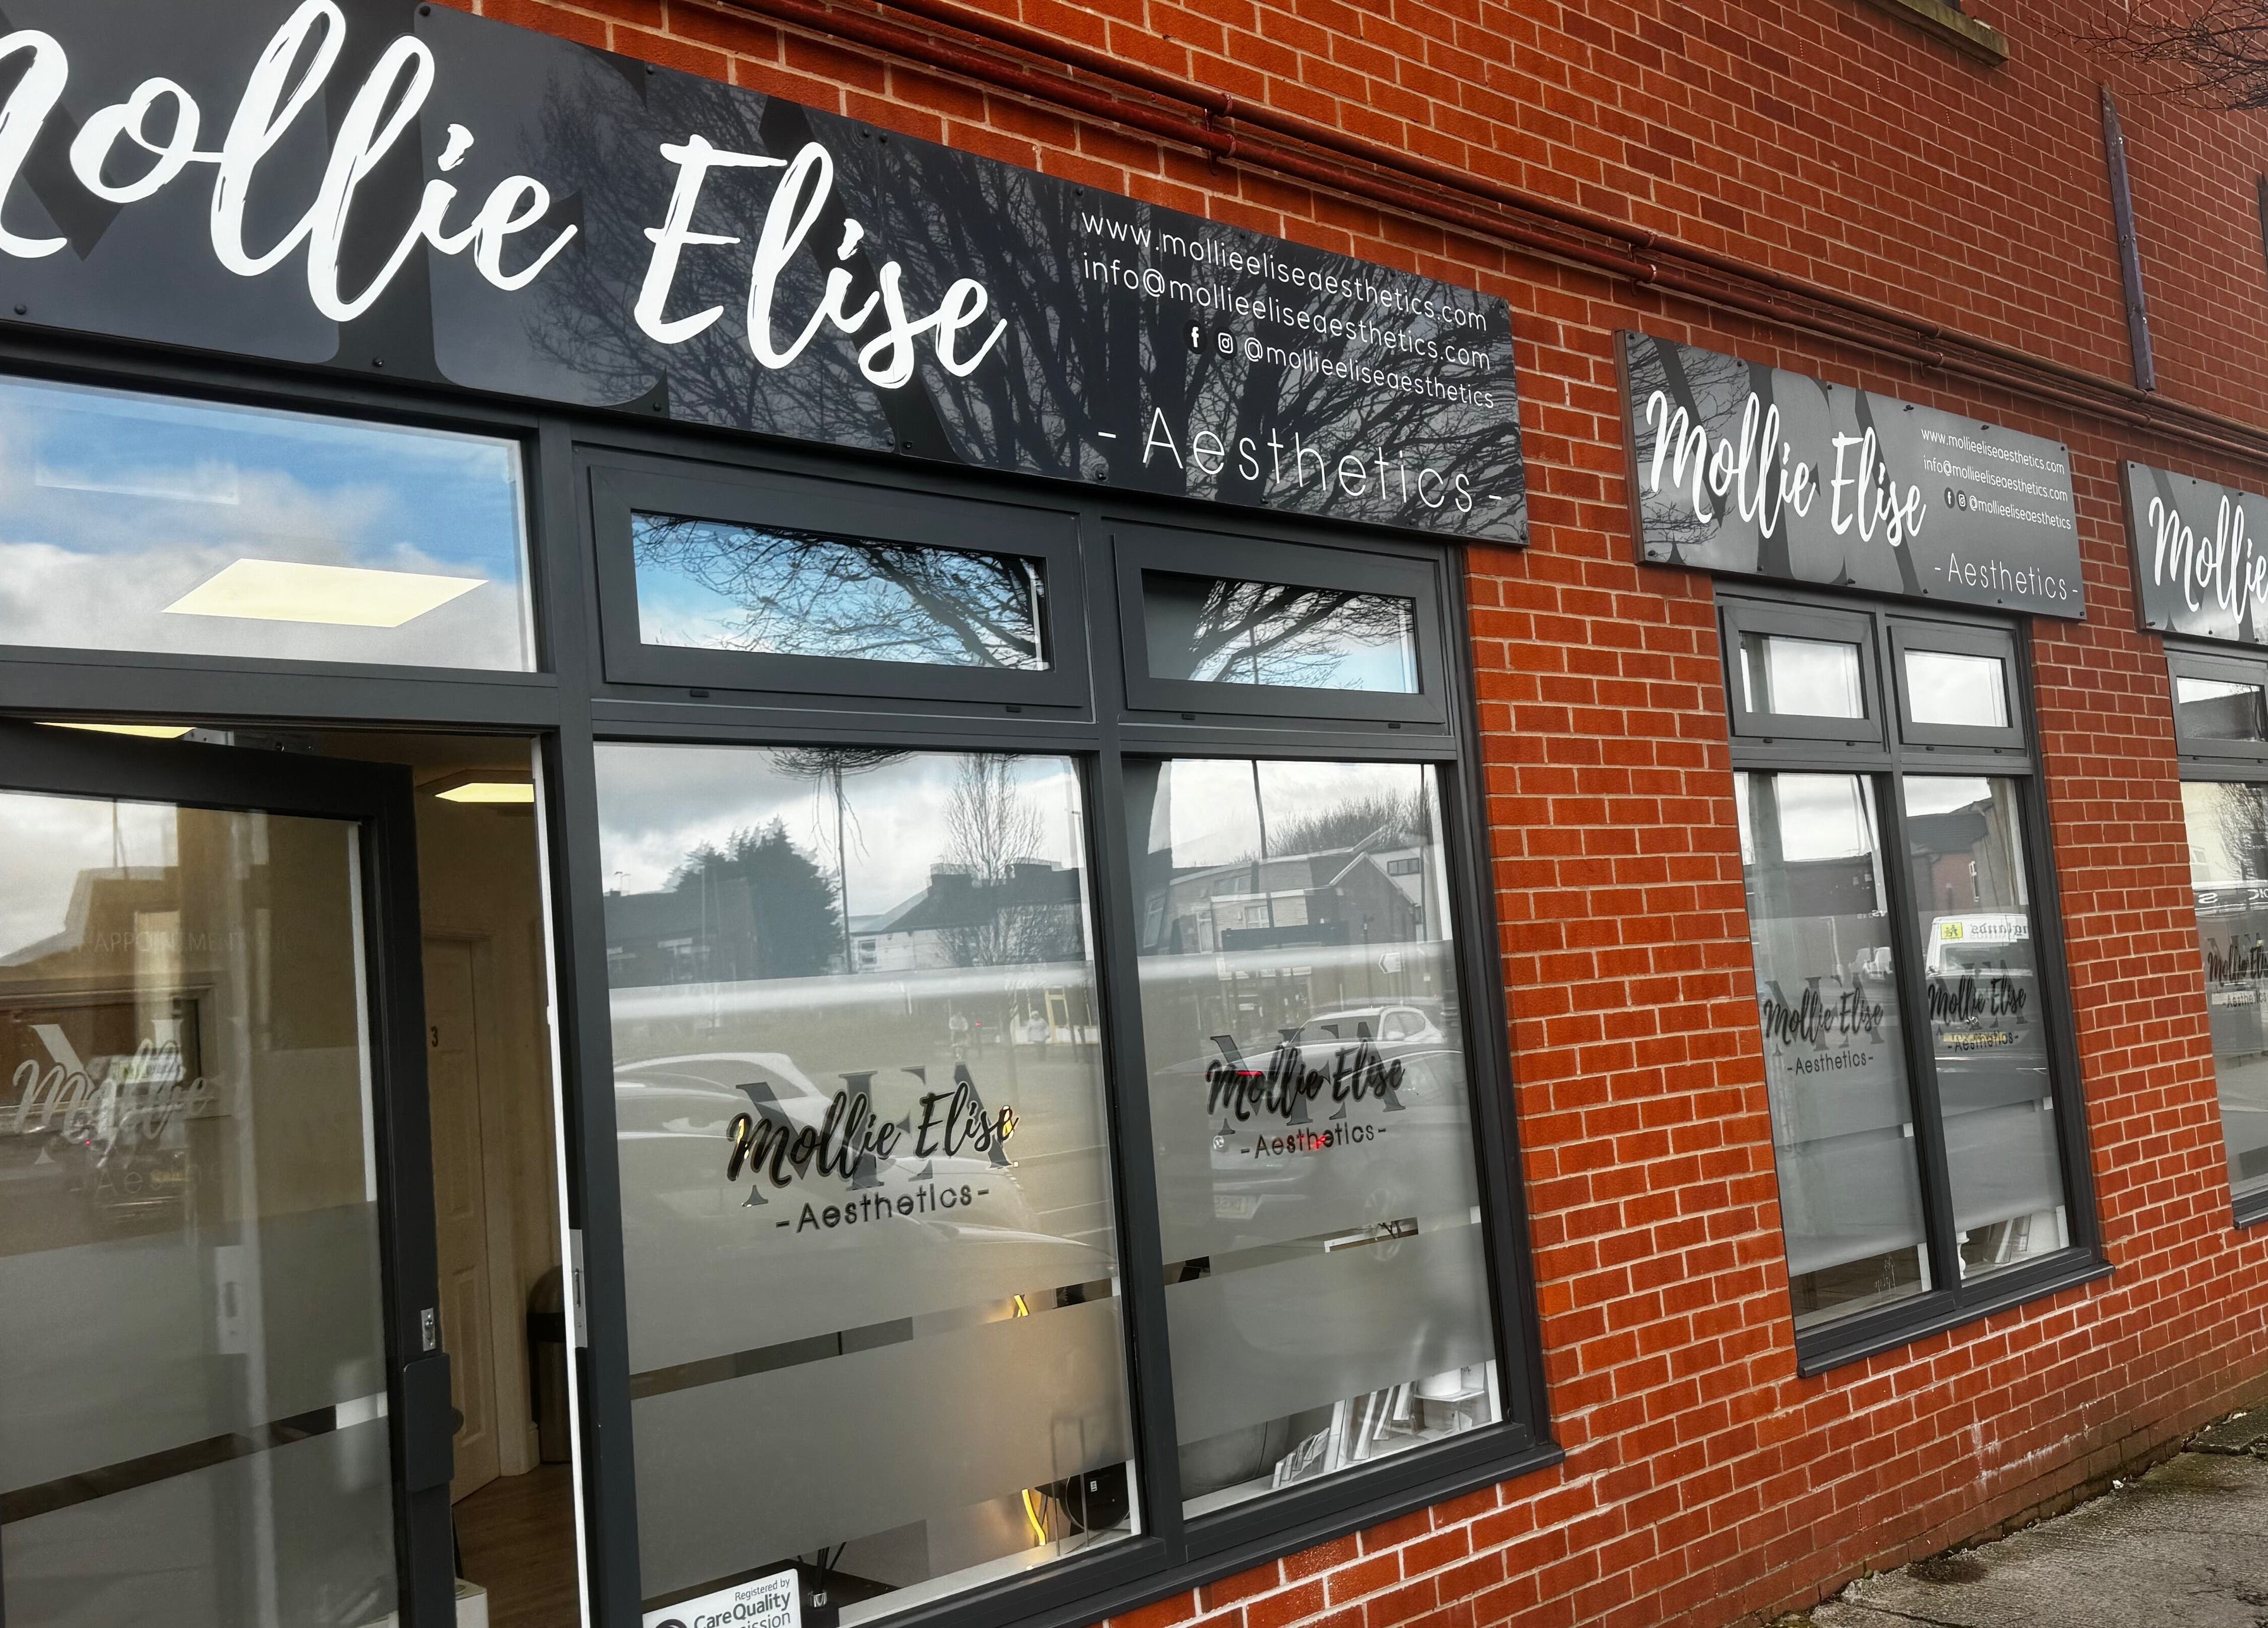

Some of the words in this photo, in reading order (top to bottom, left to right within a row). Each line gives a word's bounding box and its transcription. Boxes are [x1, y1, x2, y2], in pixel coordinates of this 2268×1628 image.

[0, 0, 577, 322] ollie
[634, 134, 1008, 389] Elise
[1081, 211, 1488, 332] www.mollieeliseaesthetics.com
[1083, 253, 1491, 371] info@mollieeliseaesthetics.com
[1244, 337, 1494, 409] @mollieeliseaesthetics
[1645, 390, 1817, 539] Mollie
[1830, 426, 1927, 547] Elise
[1921, 428, 2065, 476] www.mollieeliseaesthetics.com
[1923, 455, 2068, 502] info@mollieeliseaesthetics.com
[1969, 496, 2071, 530] @mollieeliseaesthetics
[2148, 494, 2268, 624] Mollie
[1762, 988, 1834, 1046] Mollie
[1840, 988, 1884, 1034] Elise
[1928, 975, 1986, 1025] Mollie
[1990, 975, 2026, 1016] Elise
[1205, 1043, 1325, 1121] Mollie
[1331, 1038, 1406, 1102] Elise
[726, 1089, 901, 1188] Mollie
[913, 1082, 1019, 1158] Elise
[735, 1580, 778, 1602] Registered
[780, 1578, 790, 1589] by
